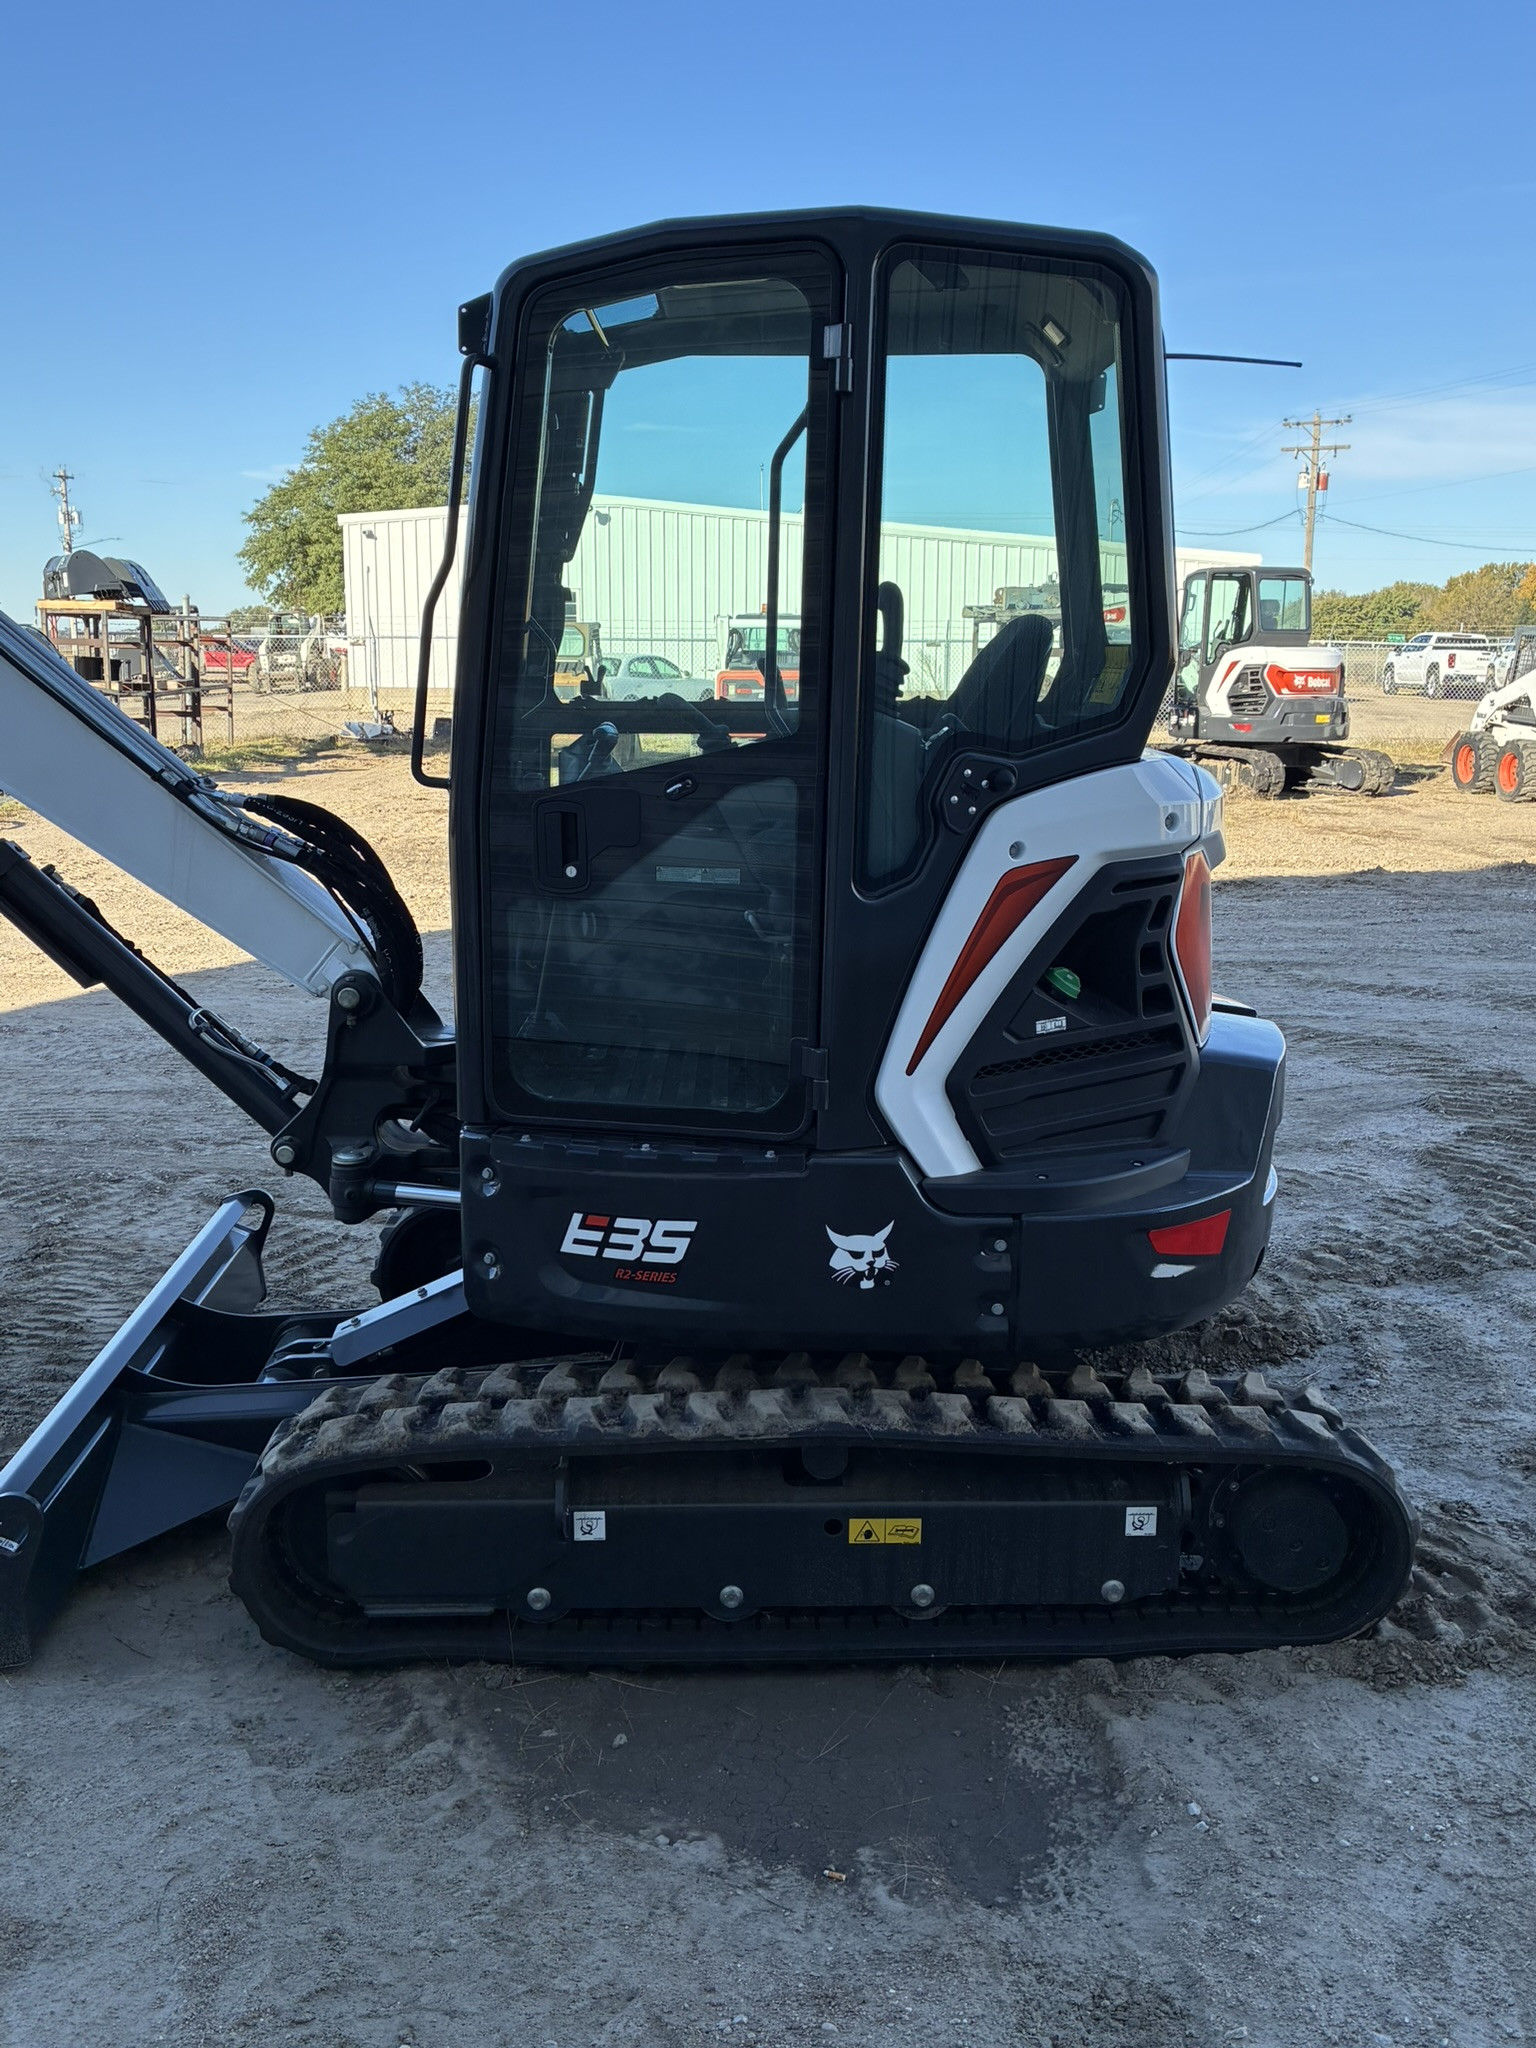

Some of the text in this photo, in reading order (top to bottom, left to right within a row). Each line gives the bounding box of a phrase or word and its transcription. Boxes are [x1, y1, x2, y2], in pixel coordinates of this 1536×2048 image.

[1307, 676, 1331, 688] Bobcat
[560, 1212, 698, 1264] E35
[615, 1268, 677, 1283] R2-SERIES
